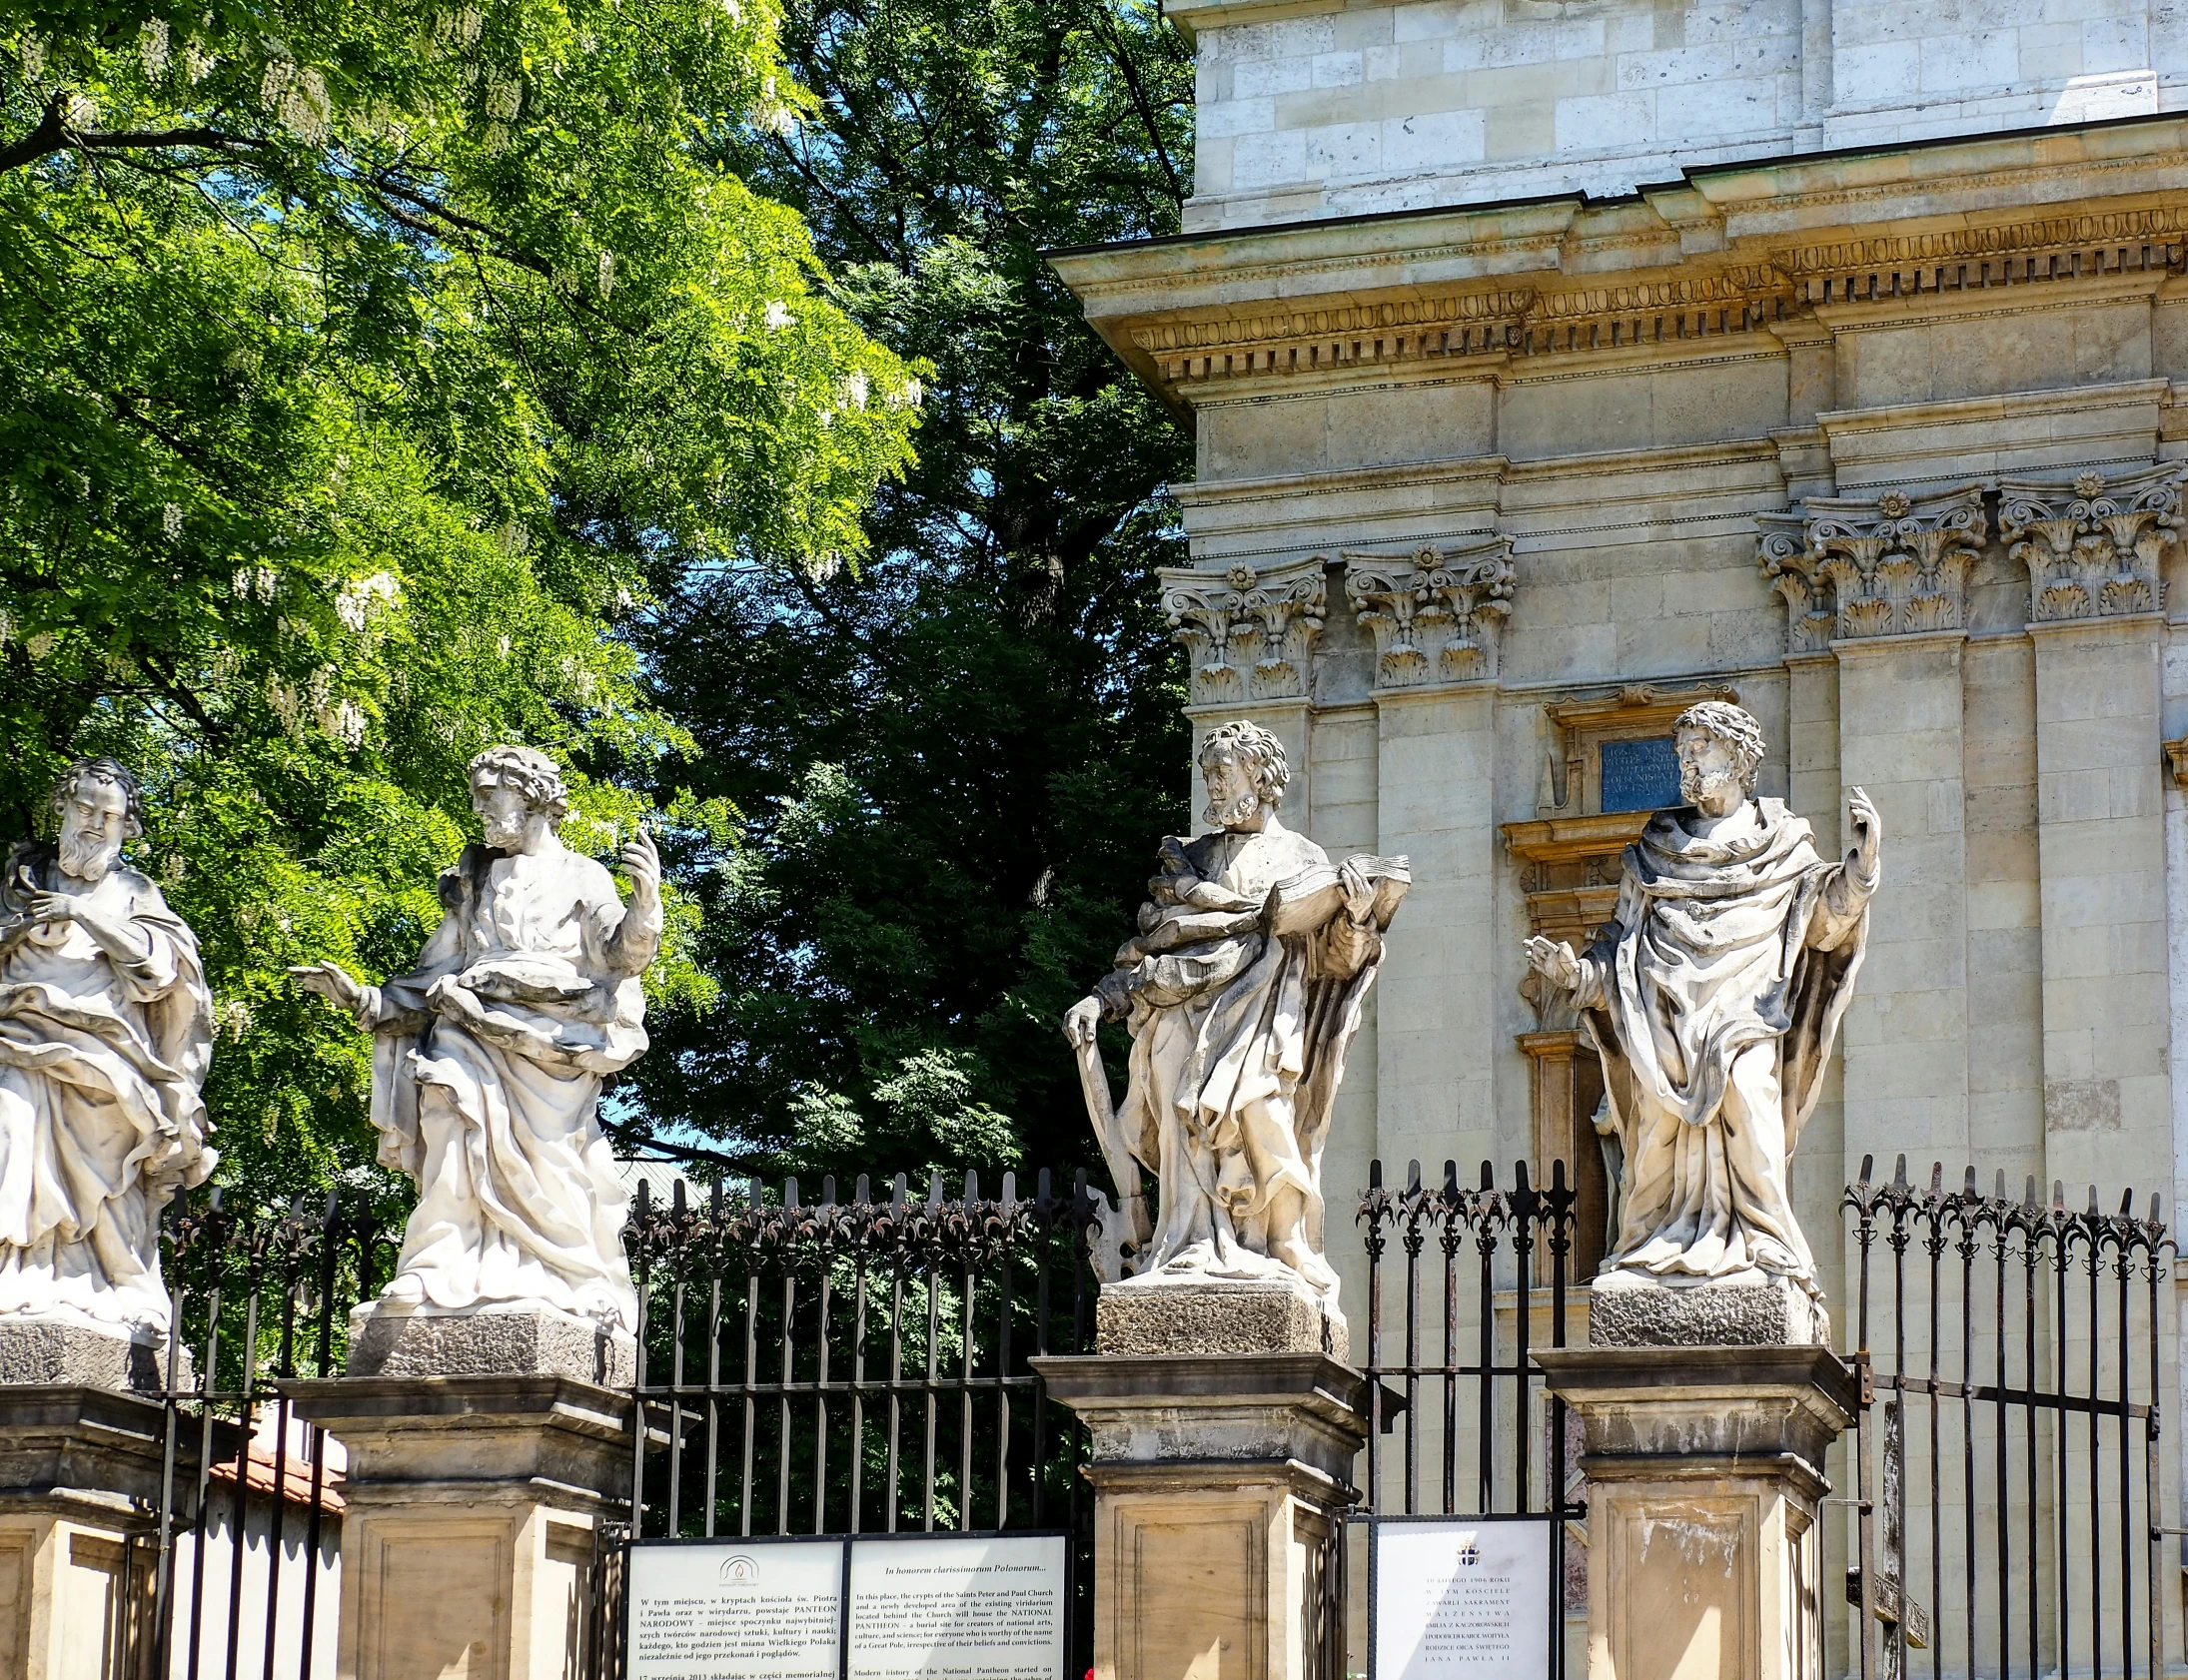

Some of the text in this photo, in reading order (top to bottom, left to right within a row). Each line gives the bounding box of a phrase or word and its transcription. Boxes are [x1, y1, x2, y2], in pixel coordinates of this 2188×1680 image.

[653, 1598, 669, 1607] tym
[721, 1596, 756, 1606] kryptach
[879, 1592, 899, 1602] place,
[912, 1592, 934, 1601] crypts
[880, 1601, 900, 1611] newly
[903, 1601, 937, 1611] developed
[984, 1599, 1012, 1609] existing
[755, 1606, 789, 1616] powstaje
[707, 1618, 736, 1628] miejsce
[740, 1617, 781, 1627] spoczynku
[639, 1630, 660, 1640] szych
[699, 1628, 740, 1639] narodowej
[772, 1627, 802, 1637] kultury
[854, 1631, 881, 1640] culture,
[987, 1628, 1012, 1638] worthy
[690, 1640, 721, 1650] godzien
[724, 1640, 737, 1649] jest
[768, 1638, 807, 1648] Wielkiego
[889, 1640, 905, 1649] Pole,
[906, 1640, 947, 1650] irrespective
[695, 1652, 711, 1661] jego
[713, 1650, 754, 1661] przekonań
[761, 1649, 800, 1660] poglądów.
[785, 1670, 835, 1680] memorialnej
